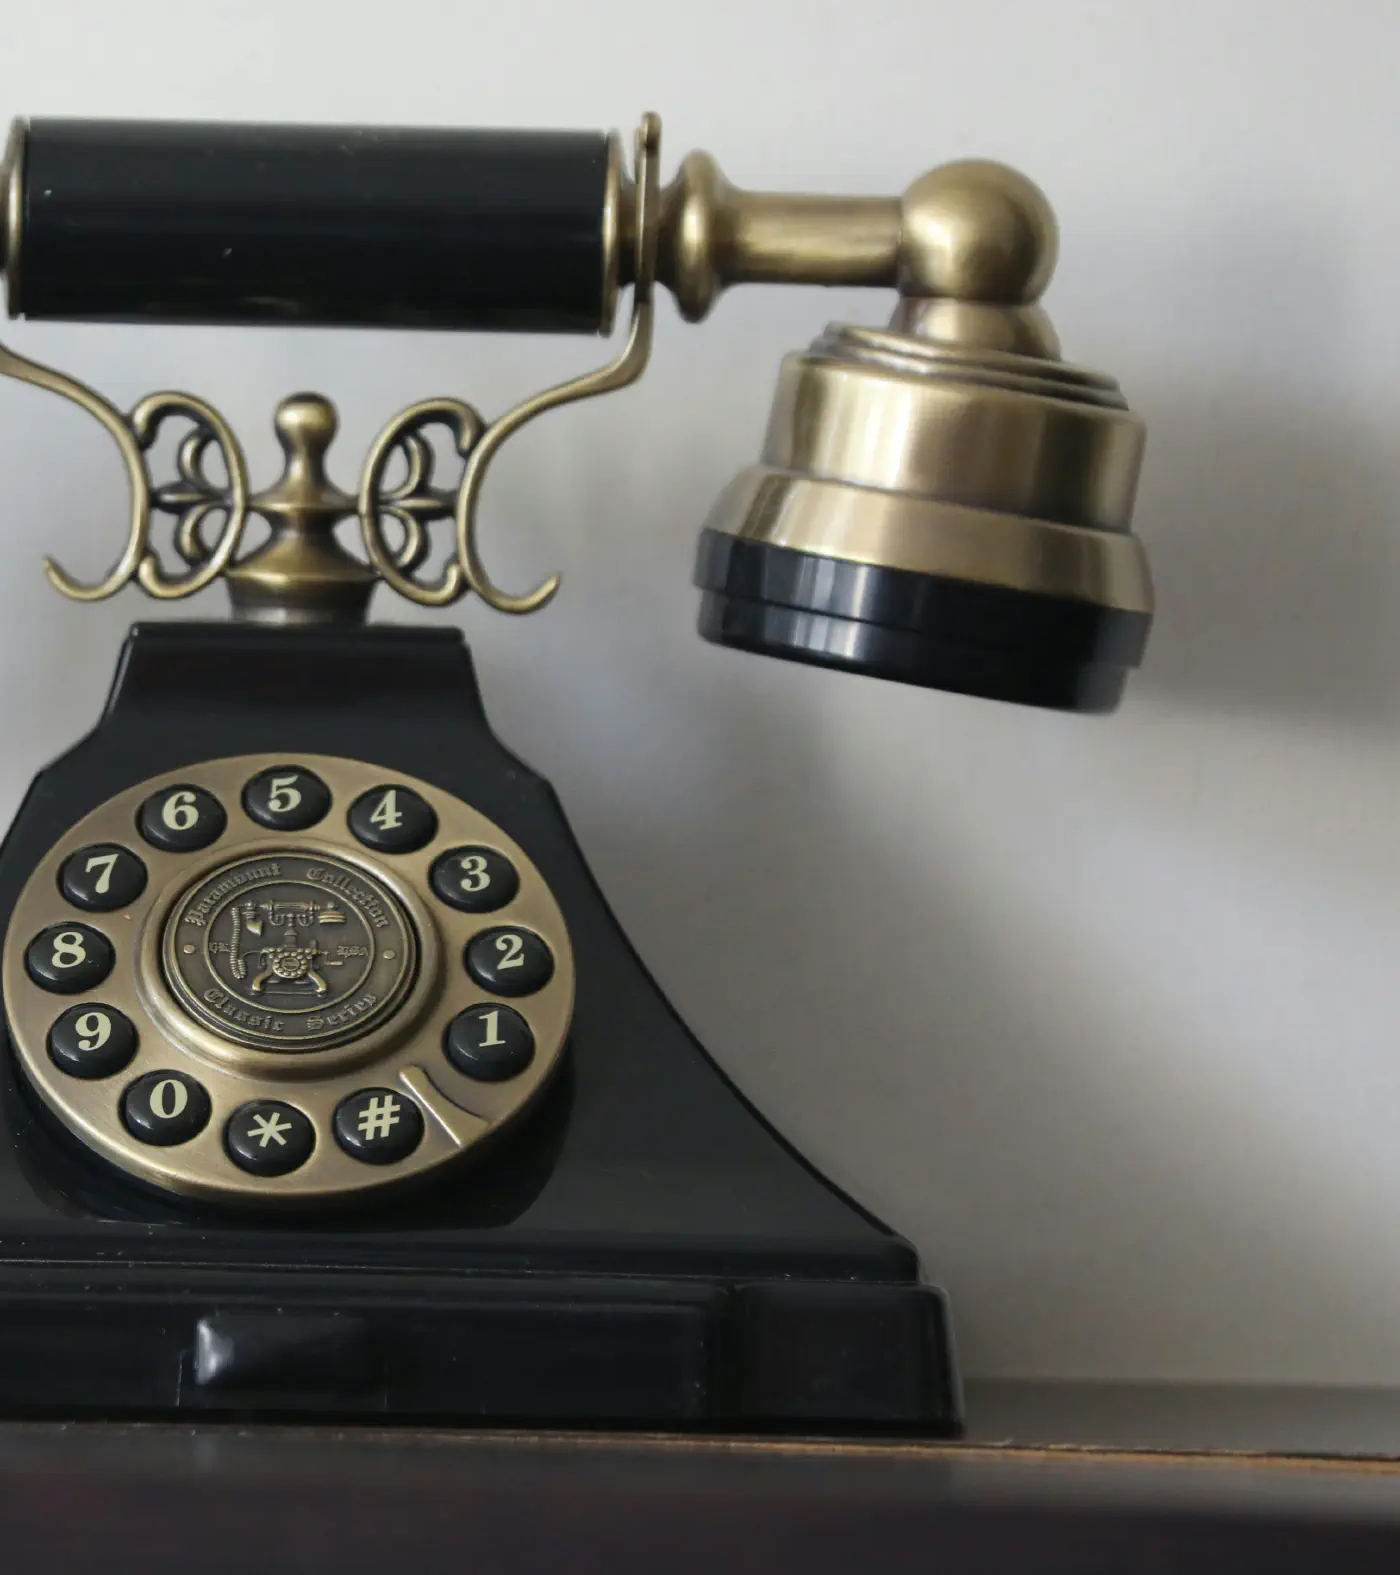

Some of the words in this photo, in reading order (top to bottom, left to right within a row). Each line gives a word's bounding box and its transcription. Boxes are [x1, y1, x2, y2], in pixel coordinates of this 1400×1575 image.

[162, 791, 199, 830] 6
[268, 775, 302, 812] 5
[370, 789, 403, 831] 4
[85, 853, 119, 894] 7
[460, 855, 491, 892] 3
[184, 863, 283, 927] Paramount
[305, 866, 390, 929] Collection
[51, 931, 86, 969] 8
[495, 934, 525, 970] 2
[203, 988, 286, 1032] Classic
[306, 994, 378, 1031] Series
[478, 1010, 506, 1047] 1
[75, 1011, 112, 1052] 9
[149, 1079, 188, 1119] 0
[357, 1094, 401, 1141] #
